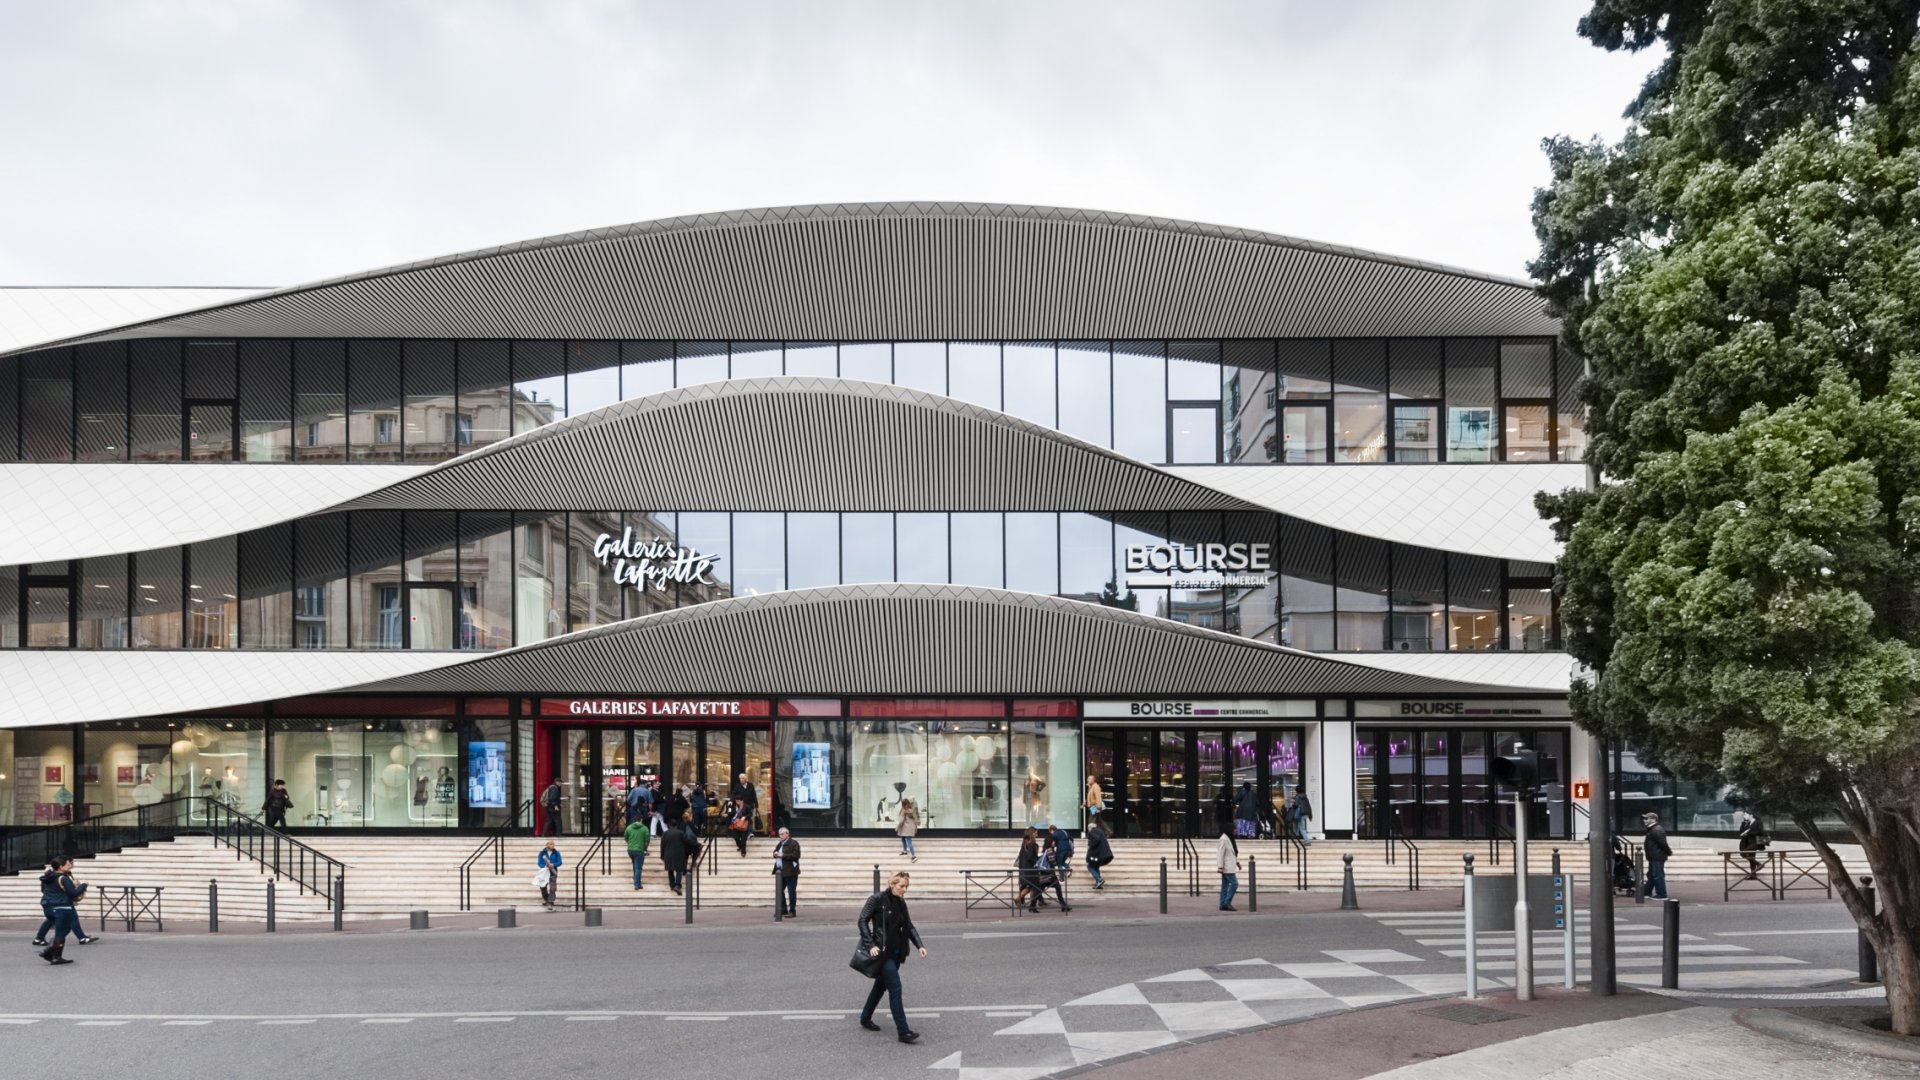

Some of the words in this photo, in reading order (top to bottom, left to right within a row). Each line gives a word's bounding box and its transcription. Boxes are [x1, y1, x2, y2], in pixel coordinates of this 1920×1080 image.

[594, 526, 677, 566] Galeries
[1127, 543, 1270, 570] BOURSE
[613, 548, 718, 592] Lafayette
[569, 701, 647, 715] GALERIES
[652, 701, 741, 715] LAFAYETTE
[1131, 703, 1193, 716] BOURSE
[1400, 702, 1465, 716] BOURSE
